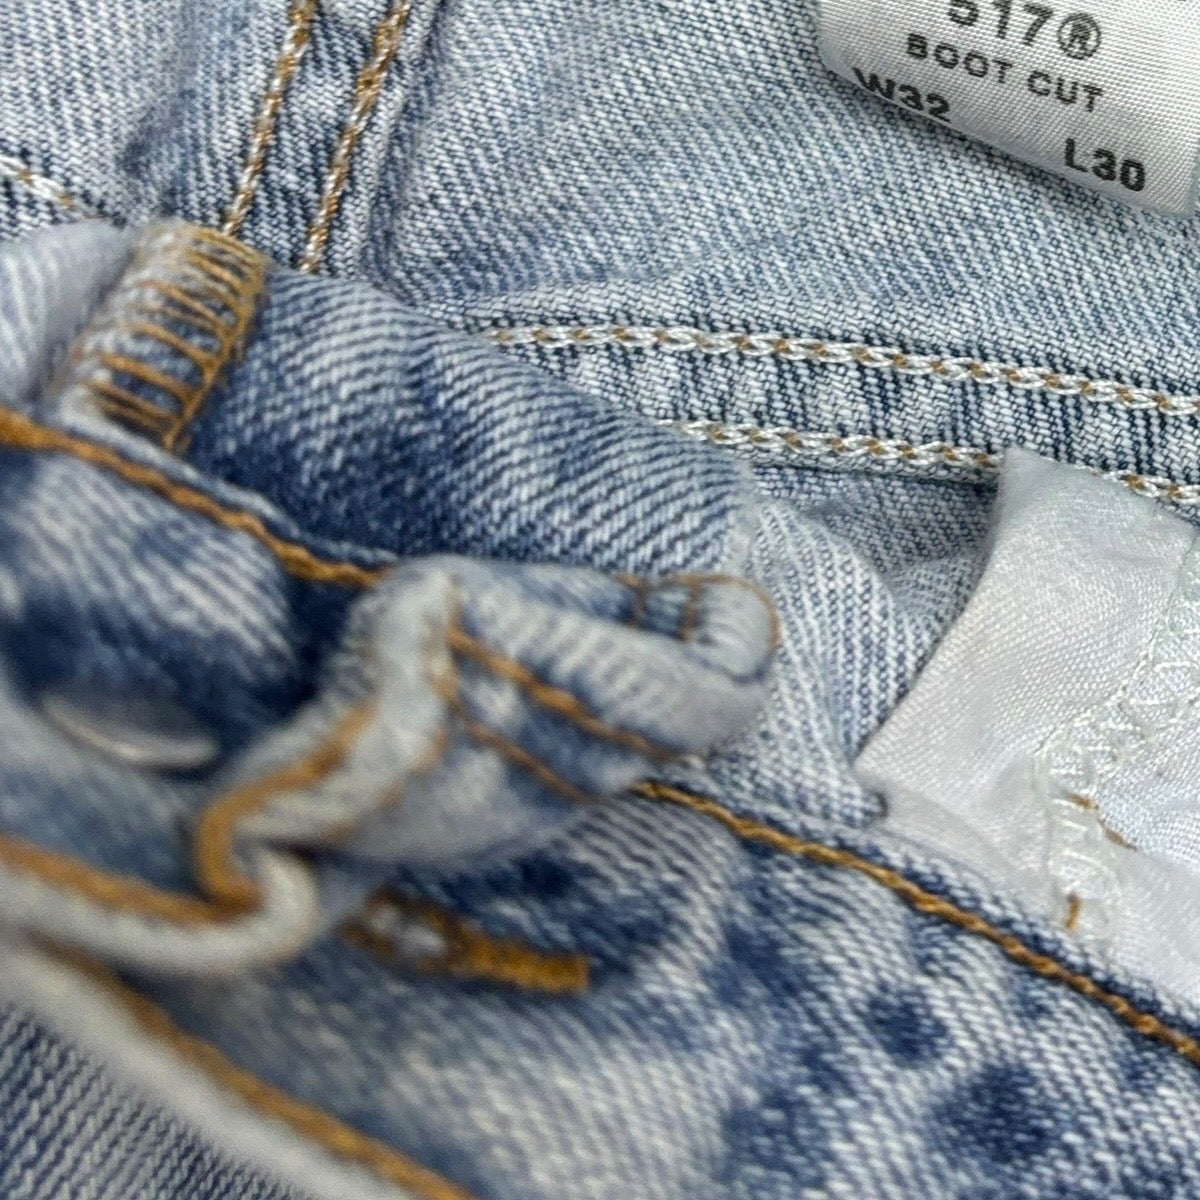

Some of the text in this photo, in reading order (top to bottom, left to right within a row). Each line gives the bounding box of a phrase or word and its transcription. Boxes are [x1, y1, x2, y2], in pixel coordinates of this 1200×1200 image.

[854, 66, 952, 123] W32
[906, 33, 1103, 114] BOOT CUT
[1063, 138, 1146, 193] L30
